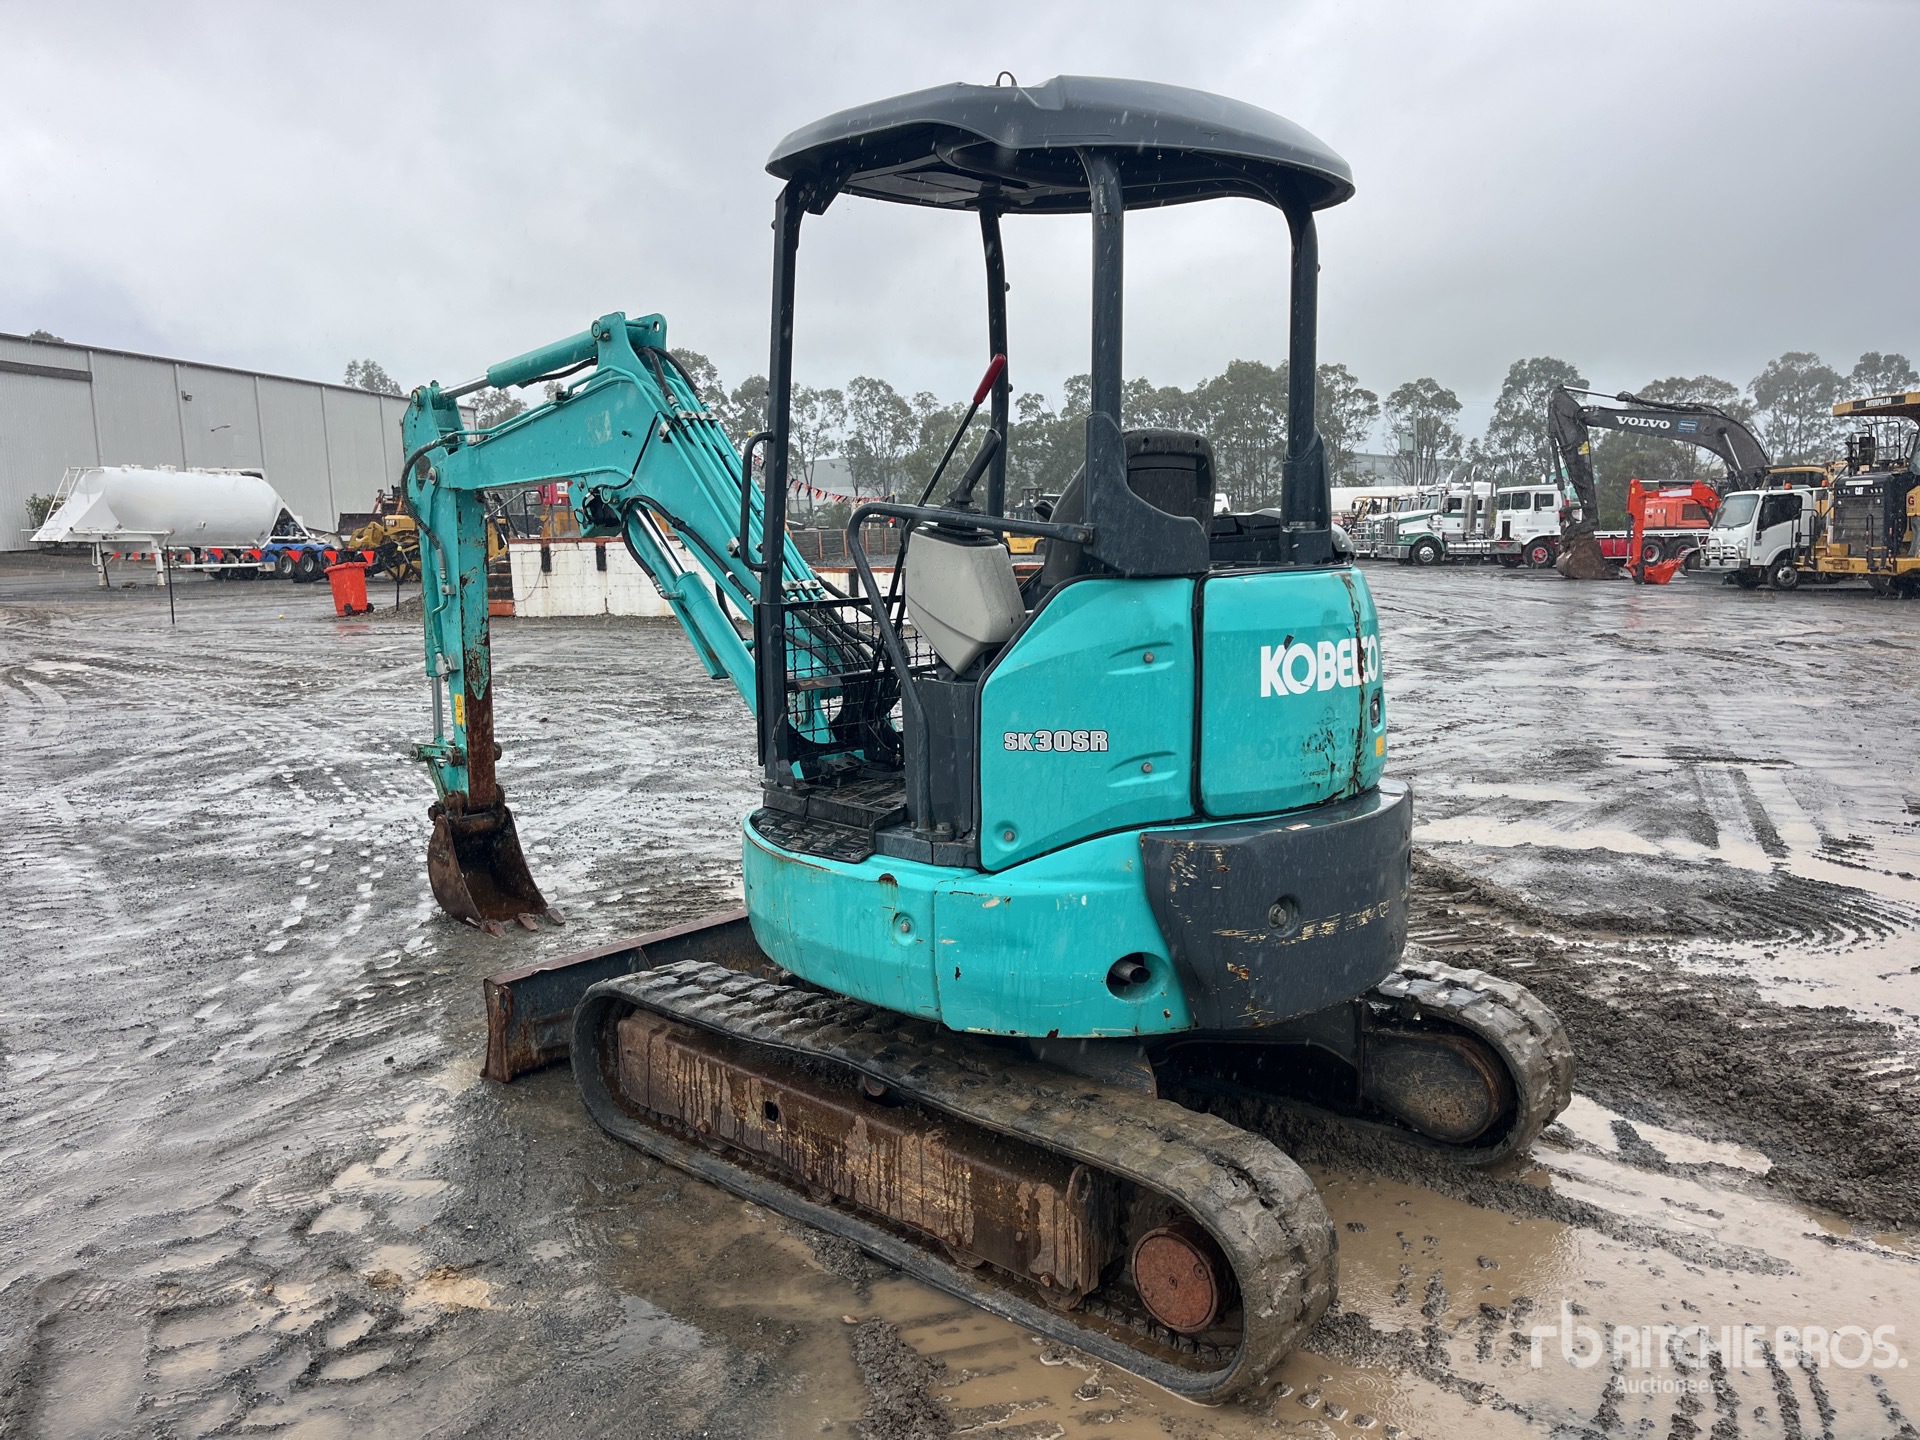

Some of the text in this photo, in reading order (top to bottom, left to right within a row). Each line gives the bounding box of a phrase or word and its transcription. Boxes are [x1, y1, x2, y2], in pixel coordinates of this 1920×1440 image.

[1616, 416, 1670, 429] VOLVO
[1855, 487, 1864, 495] CAT
[1260, 634, 1378, 697] KOBELCO
[1003, 729, 1109, 752] SK30SR
